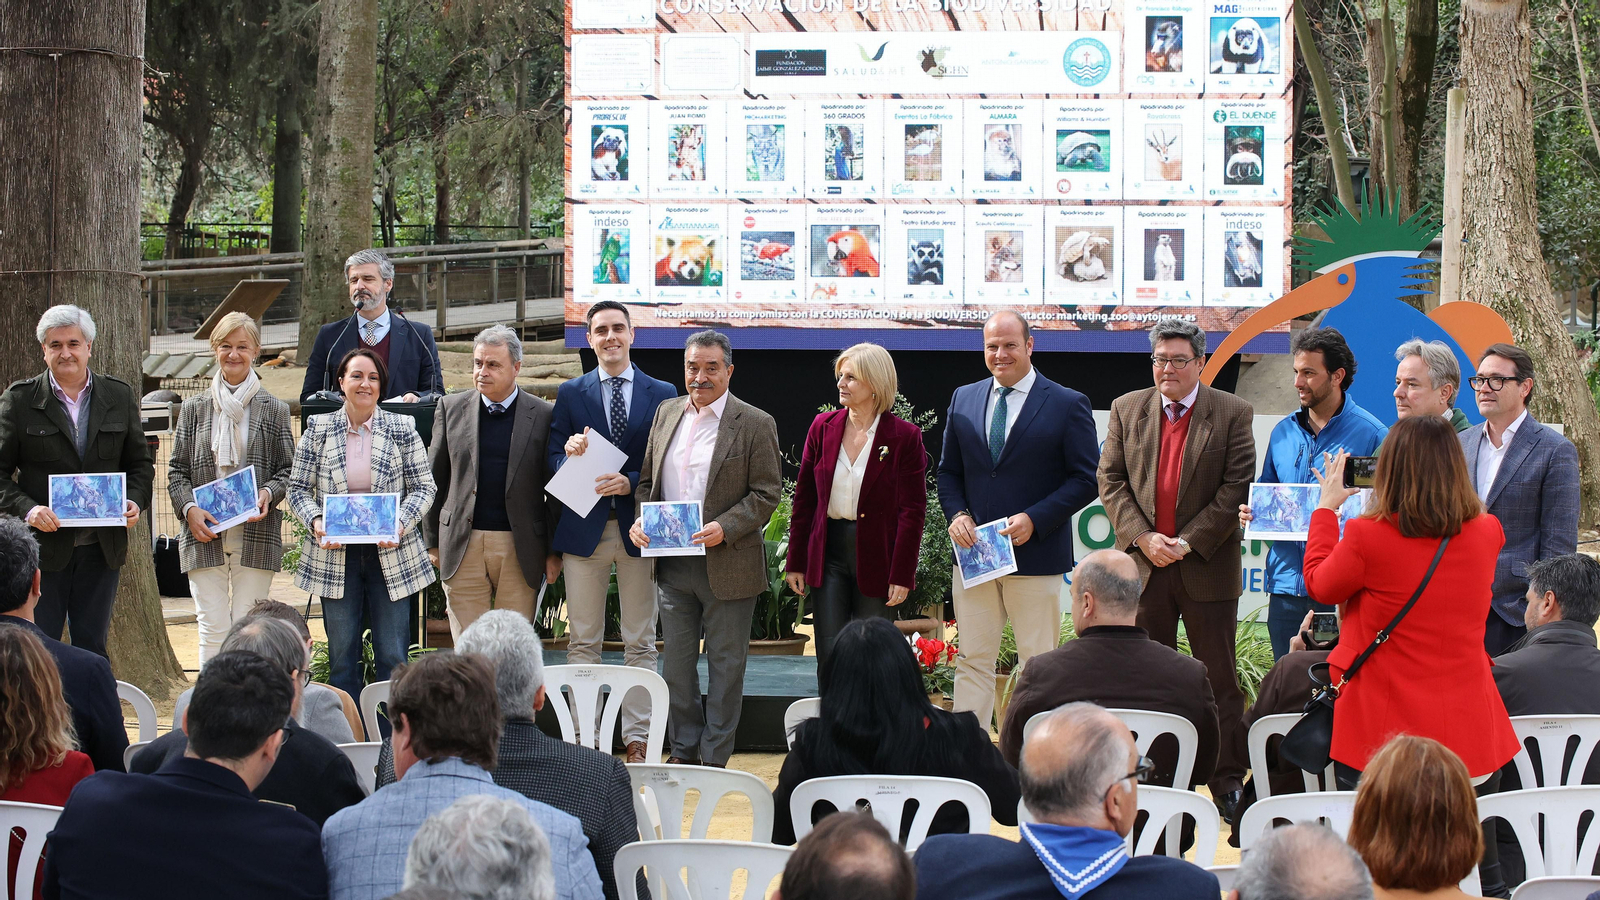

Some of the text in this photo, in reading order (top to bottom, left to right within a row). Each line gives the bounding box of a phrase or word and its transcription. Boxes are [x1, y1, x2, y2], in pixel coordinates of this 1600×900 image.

[1229, 110, 1277, 119] EL DUENDE
[594, 216, 629, 226] indeso
[1225, 218, 1263, 229] indeso
[717, 310, 728, 319] tu
[729, 310, 789, 321] compromiso
[790, 311, 808, 319] con
[810, 309, 821, 319] la
[900, 310, 914, 320] de
[915, 310, 925, 320] la
